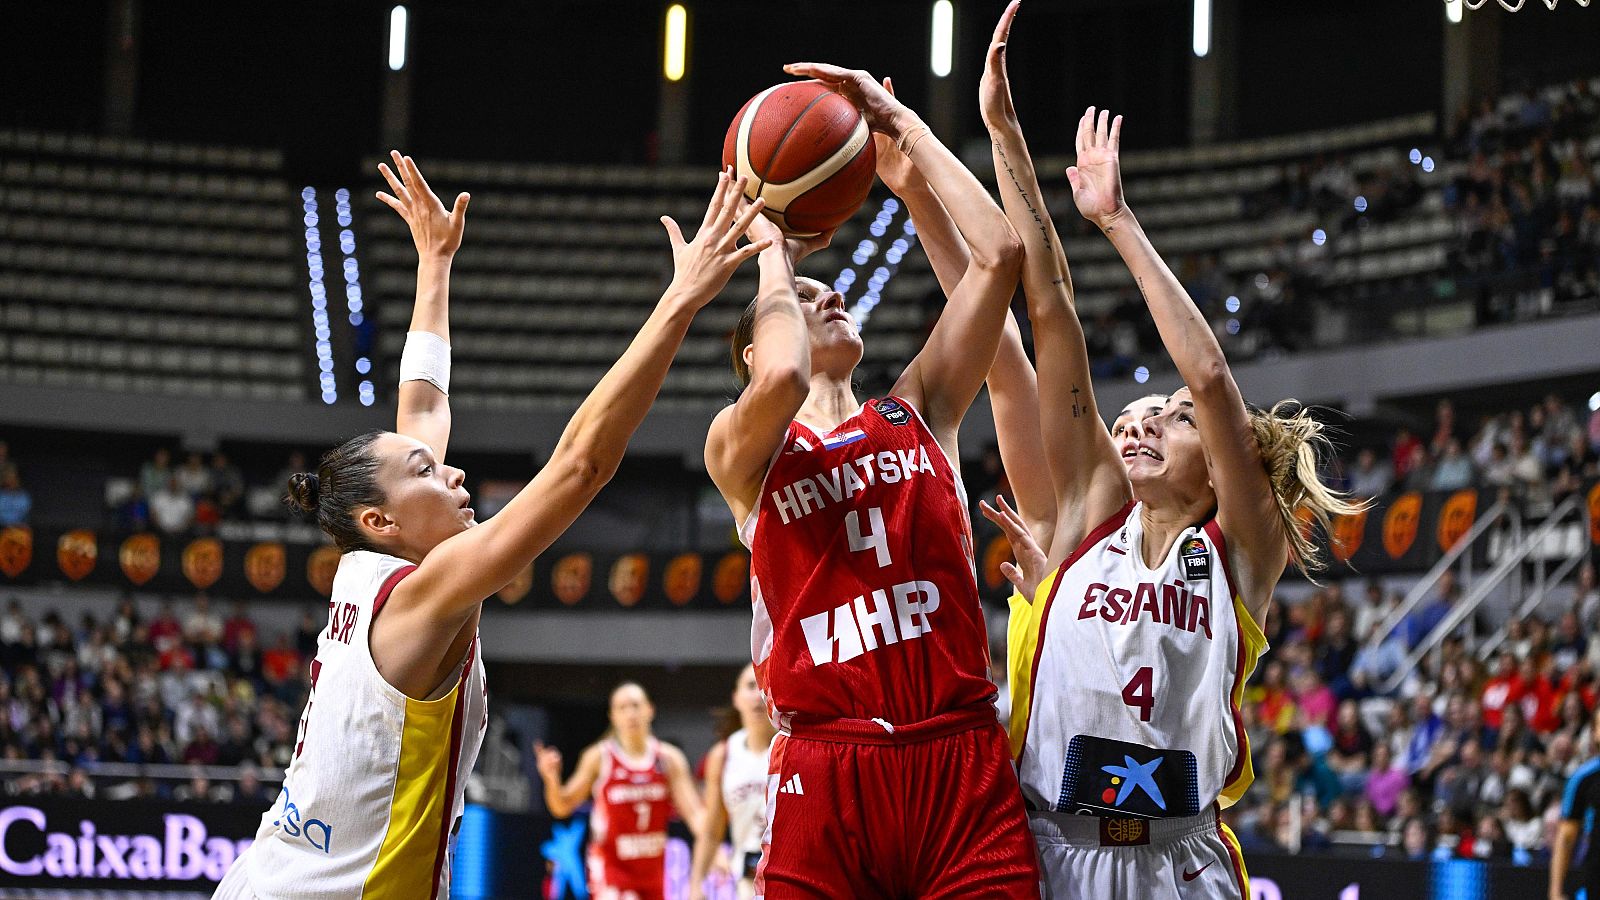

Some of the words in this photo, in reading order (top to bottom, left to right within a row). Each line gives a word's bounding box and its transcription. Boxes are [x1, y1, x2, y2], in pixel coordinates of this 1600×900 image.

[885, 410, 905, 420] FIBA
[771, 444, 937, 525] HRVATSKA
[844, 506, 892, 568] 4
[1187, 556, 1207, 567] FIBA
[1077, 578, 1213, 641] ESAÑA
[1121, 666, 1155, 722] 4
[0, 805, 255, 882] CaixaBa
